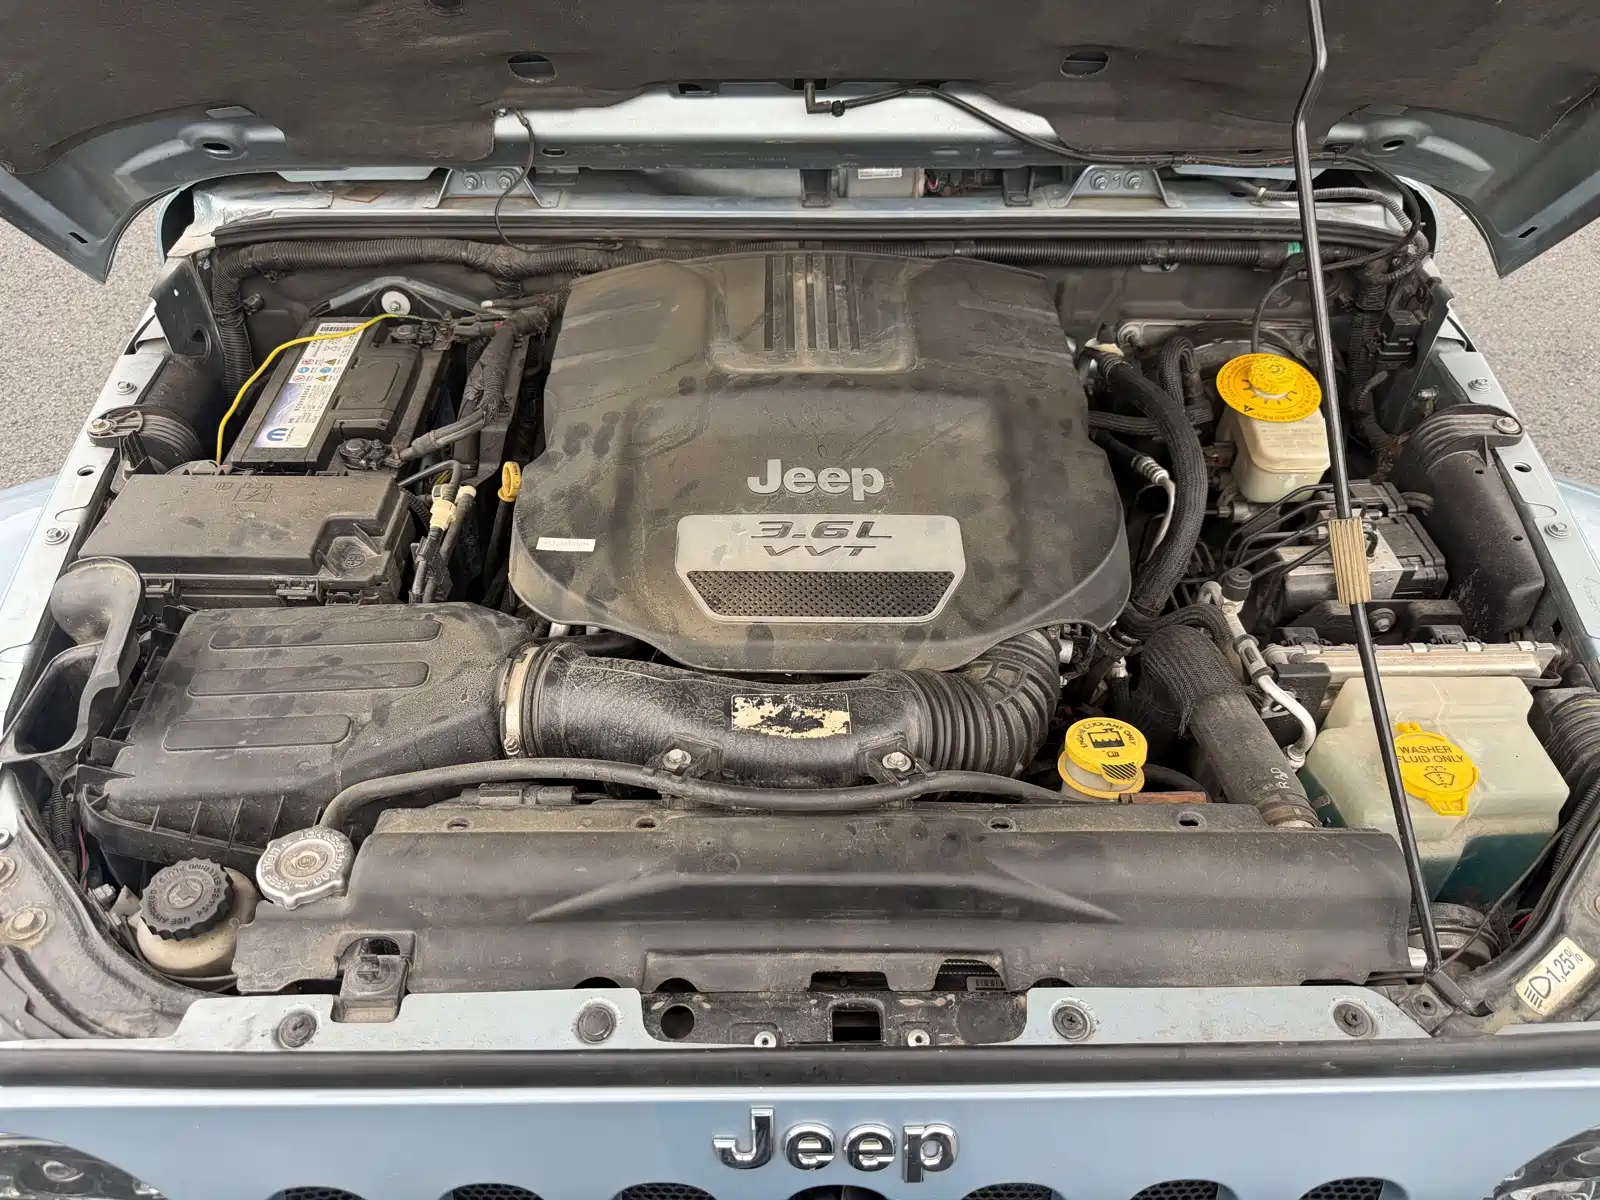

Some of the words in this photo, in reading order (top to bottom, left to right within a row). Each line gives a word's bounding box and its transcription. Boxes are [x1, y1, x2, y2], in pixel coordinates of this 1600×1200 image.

[747, 459, 885, 502] Jeep
[751, 520, 893, 539] 3.6L
[762, 545, 877, 557] VVT
[1076, 728, 1088, 748] ENGINE
[1083, 722, 1124, 730] COOLANT
[1124, 730, 1136, 746] ONLY
[1397, 745, 1452, 754] WASHER
[1433, 755, 1464, 763] ONLY
[1546, 946, 1583, 983] 1,25%
[712, 1106, 960, 1184] Jeep
